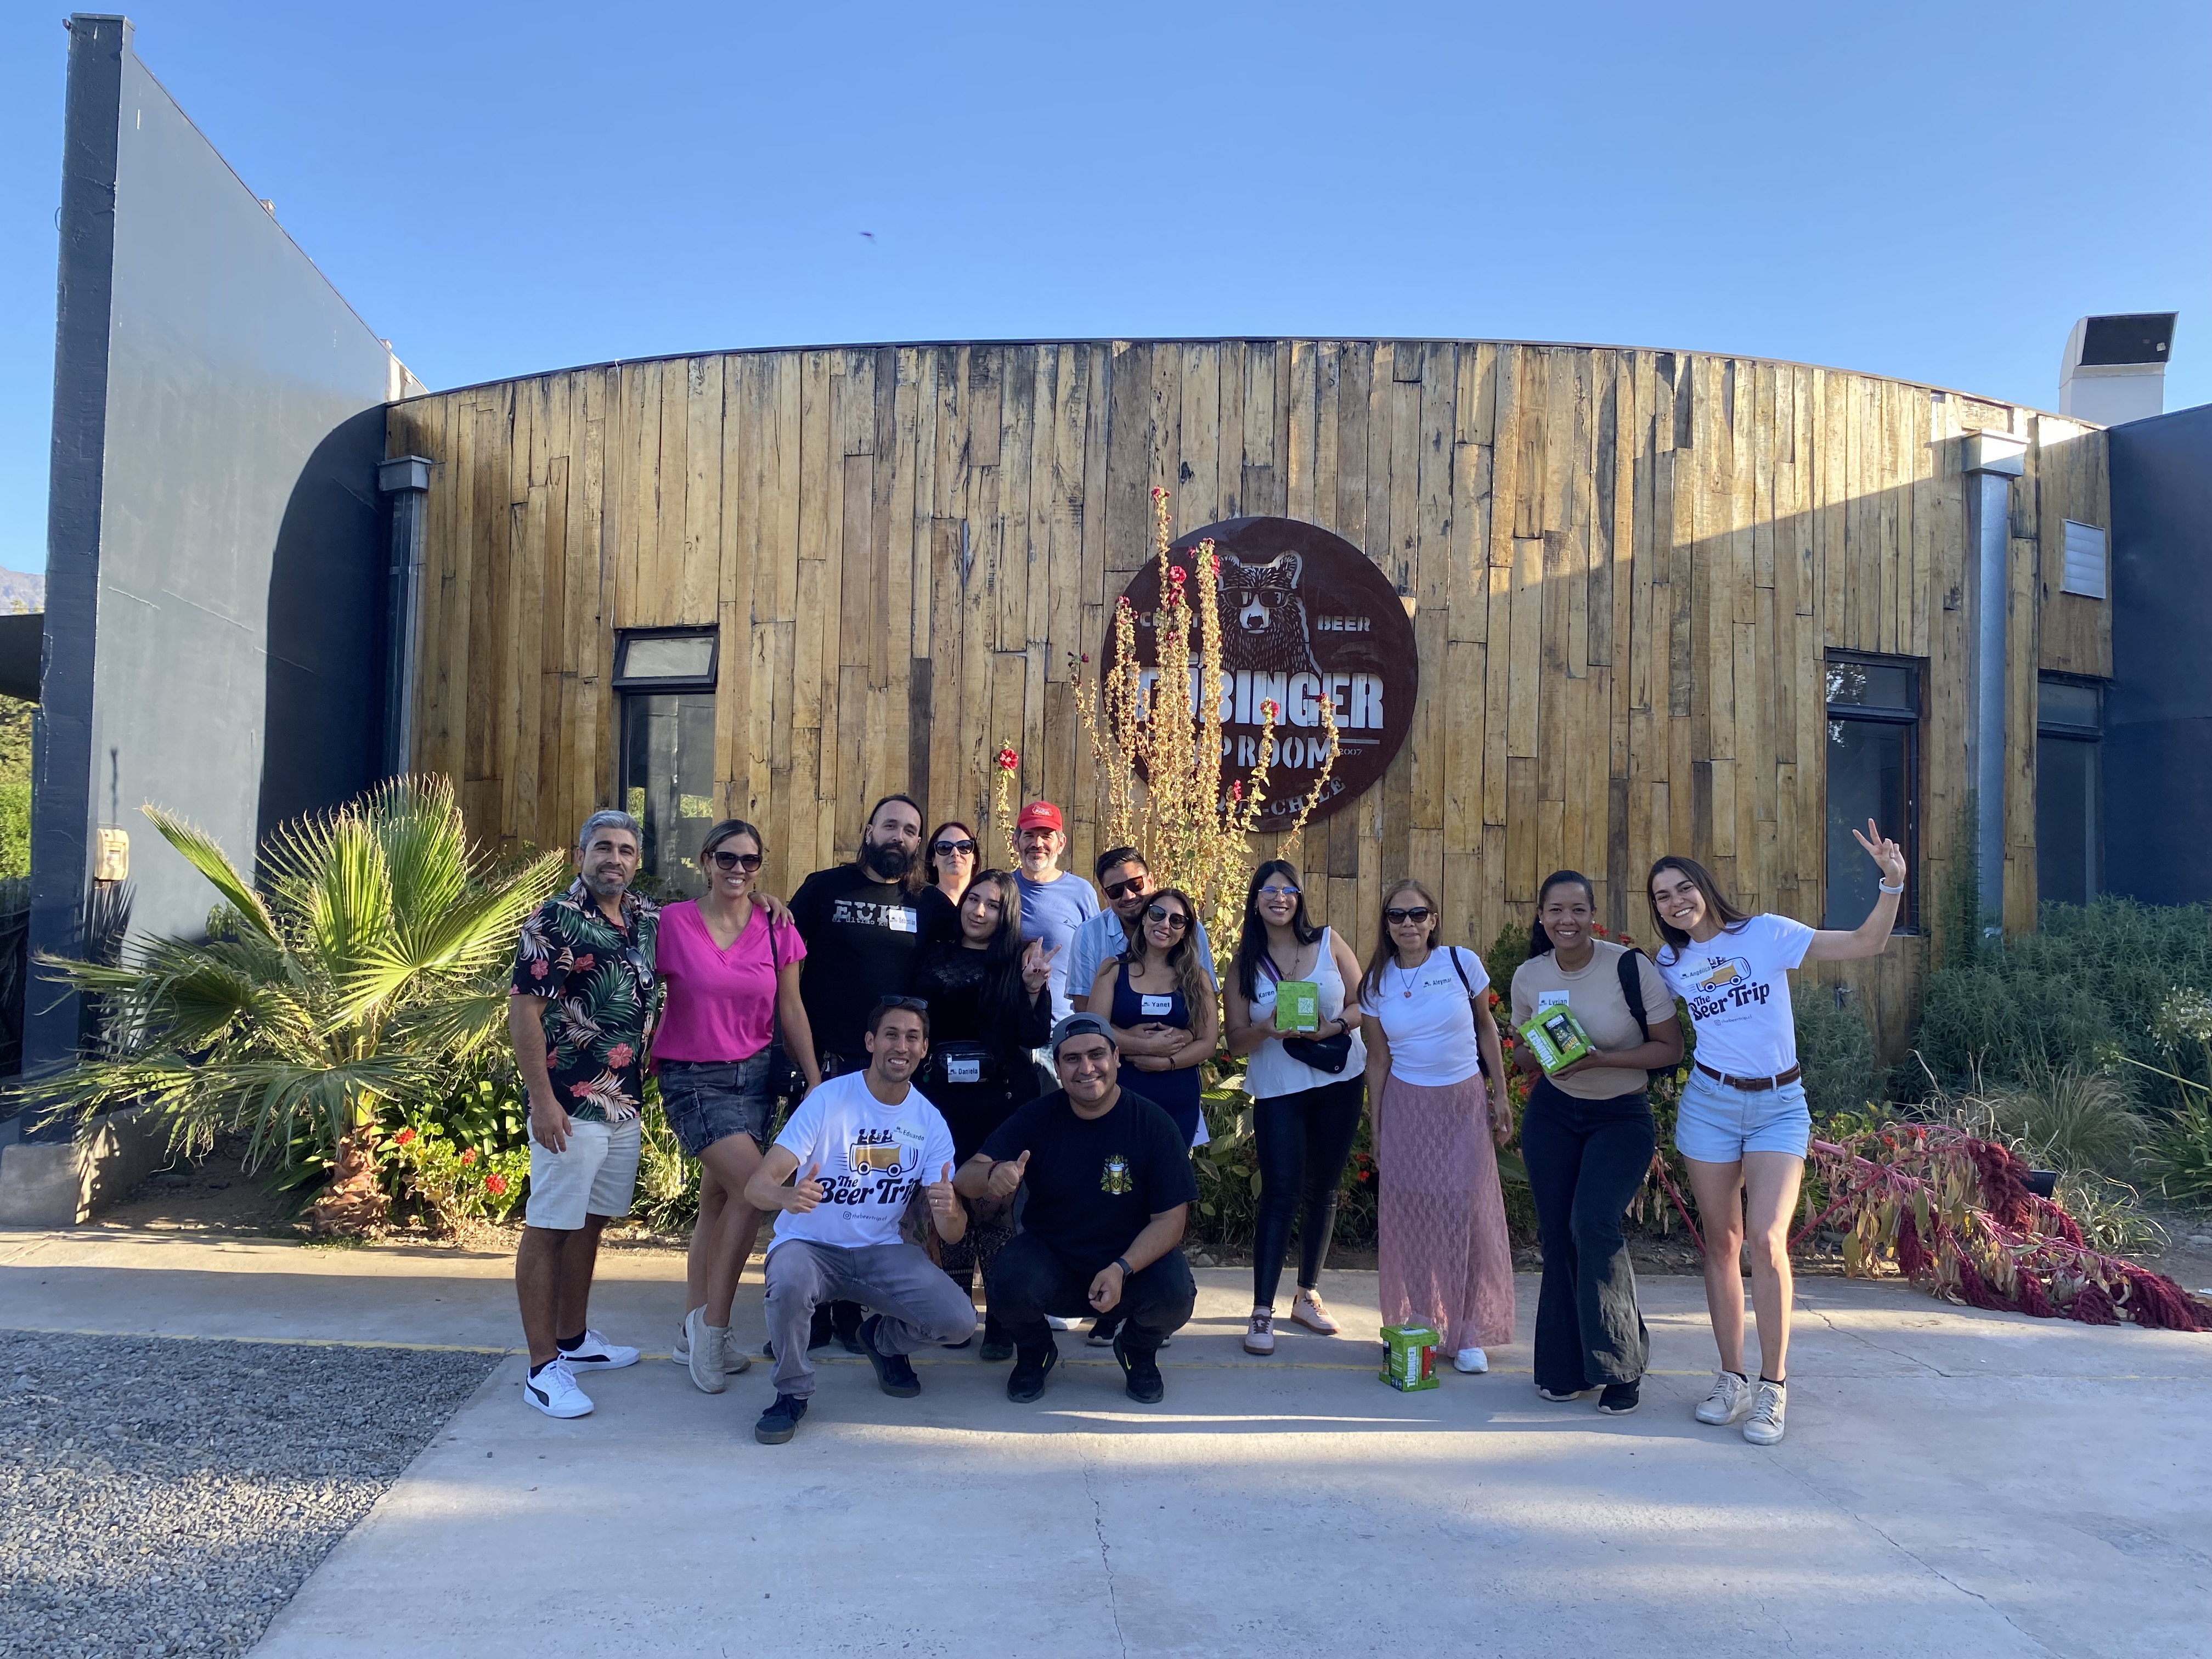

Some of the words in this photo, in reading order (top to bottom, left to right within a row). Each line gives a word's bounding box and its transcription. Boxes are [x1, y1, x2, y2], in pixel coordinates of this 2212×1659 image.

[1318, 615, 1370, 631] BEER
[1238, 735, 1331, 769] ROOM
[1258, 990, 1275, 999] Karen
[1688, 997, 1728, 1021] Beer
[1728, 982, 1770, 1007] Trip
[1694, 995, 1711, 1007] The
[1526, 1029, 1556, 1069] TÜBINGER
[903, 1129, 924, 1141] Eduardo
[814, 1177, 874, 1205] Beer
[837, 1175, 859, 1188] The
[1405, 1346, 1417, 1388] TÜBINGER
